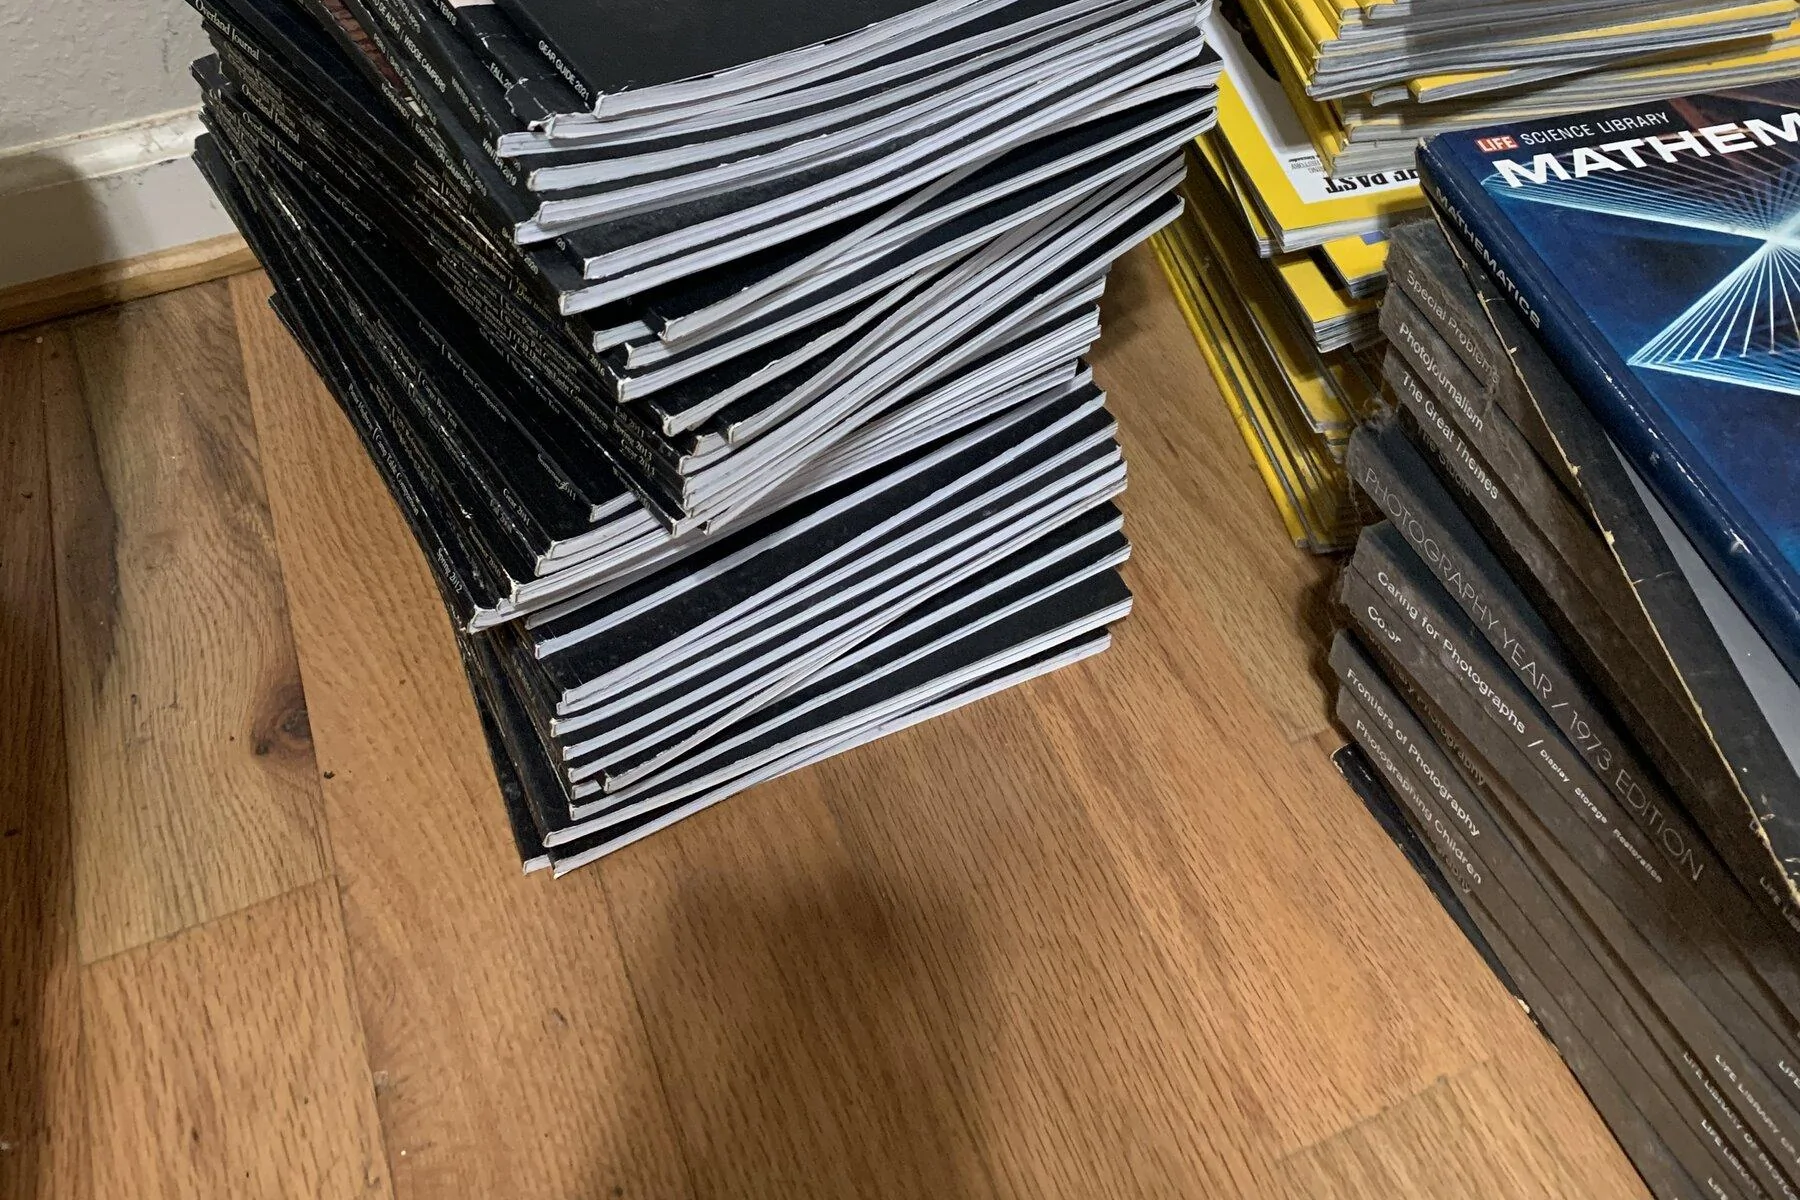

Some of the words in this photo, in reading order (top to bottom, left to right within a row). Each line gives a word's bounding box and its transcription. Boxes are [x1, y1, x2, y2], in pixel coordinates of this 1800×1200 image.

[231, 28, 260, 61] Journal
[439, 3, 457, 27] TENTS
[421, 56, 447, 94] CAMPERS
[538, 40, 557, 64] GEAR
[555, 58, 575, 85] GUIDE
[1476, 135, 1519, 152] LIFE
[1519, 123, 1596, 146] SCIENCE
[1599, 111, 1671, 134] LIBRARY
[1435, 186, 1541, 329] MATHEMATICS
[1406, 270, 1447, 321] Special
[1448, 316, 1500, 384] Problems
[1399, 322, 1485, 432] Photojournalism
[1402, 371, 1423, 403] The
[1425, 400, 1455, 443] Great
[1455, 437, 1499, 500] Themes
[1367, 605, 1402, 644] Coor
[1365, 467, 1499, 630] PHOTOGRAPHY
[1503, 627, 1553, 699] YEAR
[1570, 710, 1613, 771] 1973
[1615, 768, 1704, 882] EDITION
[1346, 668, 1394, 730] Frontiers
[1395, 729, 1407, 745] of
[1408, 743, 1481, 839] Photography
[1377, 571, 1419, 620] Caring
[1421, 616, 1441, 640] for
[1442, 638, 1526, 735] Photographs
[1539, 749, 1570, 783] Display
[1574, 787, 1608, 824] Storage
[1612, 828, 1663, 884] Restoration
[1355, 719, 1433, 822] Photographing
[1434, 819, 1483, 885] Children
[1715, 1054, 1737, 1082] LIFE
[1701, 1119, 1723, 1147] LIFE
